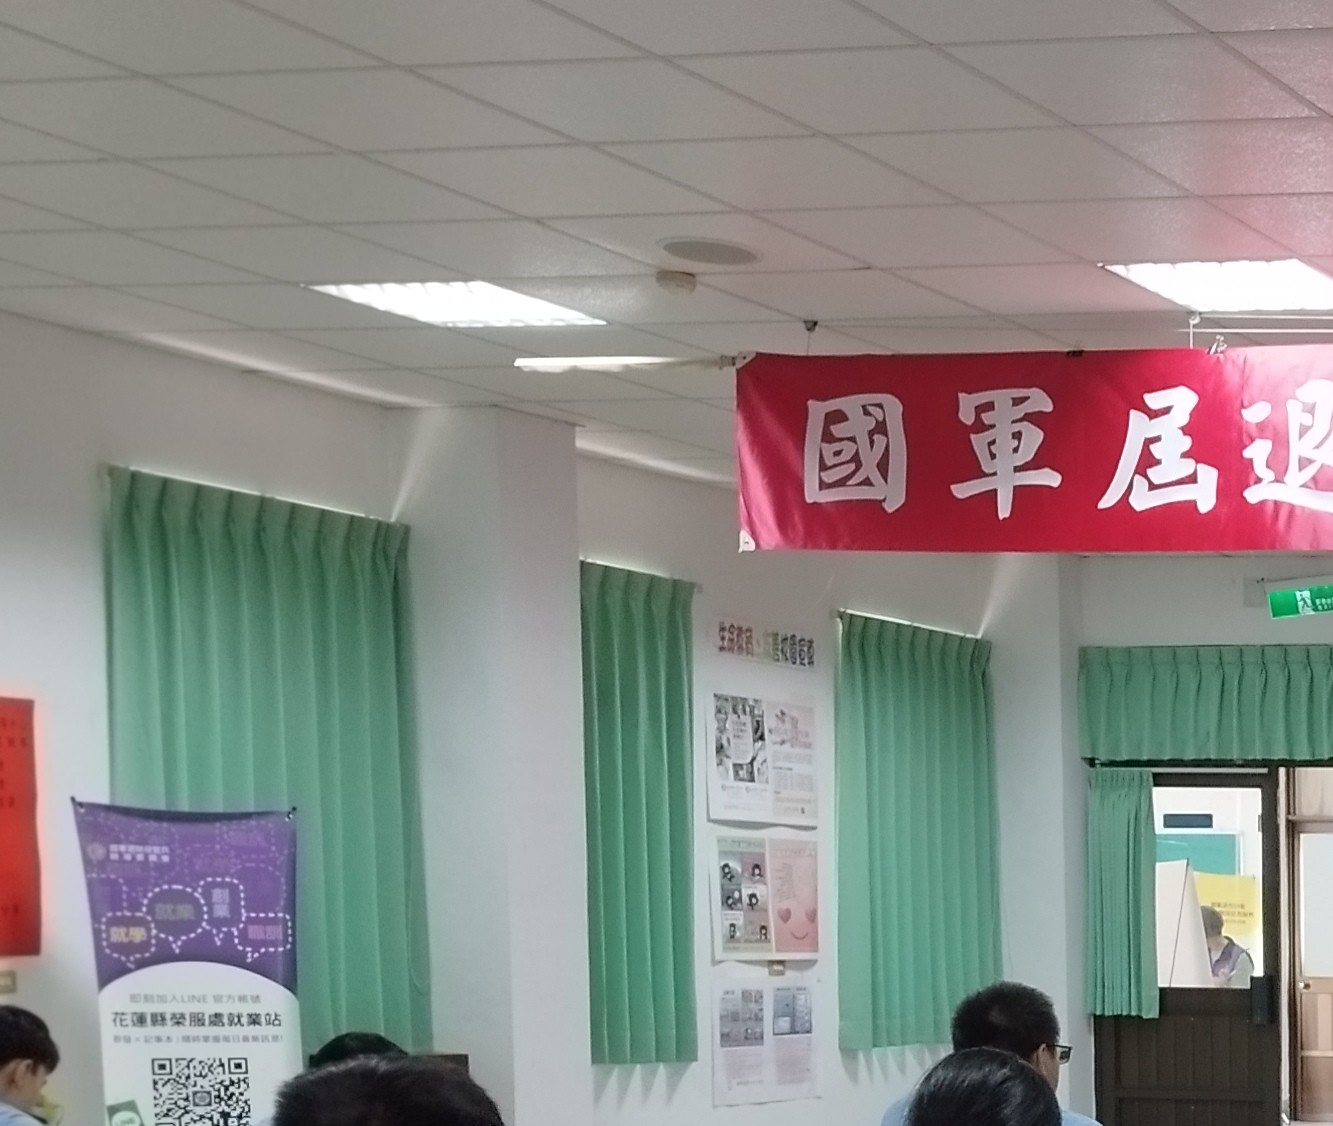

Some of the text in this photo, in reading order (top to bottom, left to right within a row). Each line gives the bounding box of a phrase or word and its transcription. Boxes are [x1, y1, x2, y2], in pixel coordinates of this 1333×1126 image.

[112, 1011, 282, 1028] 花蓮縣榮服處就業站
